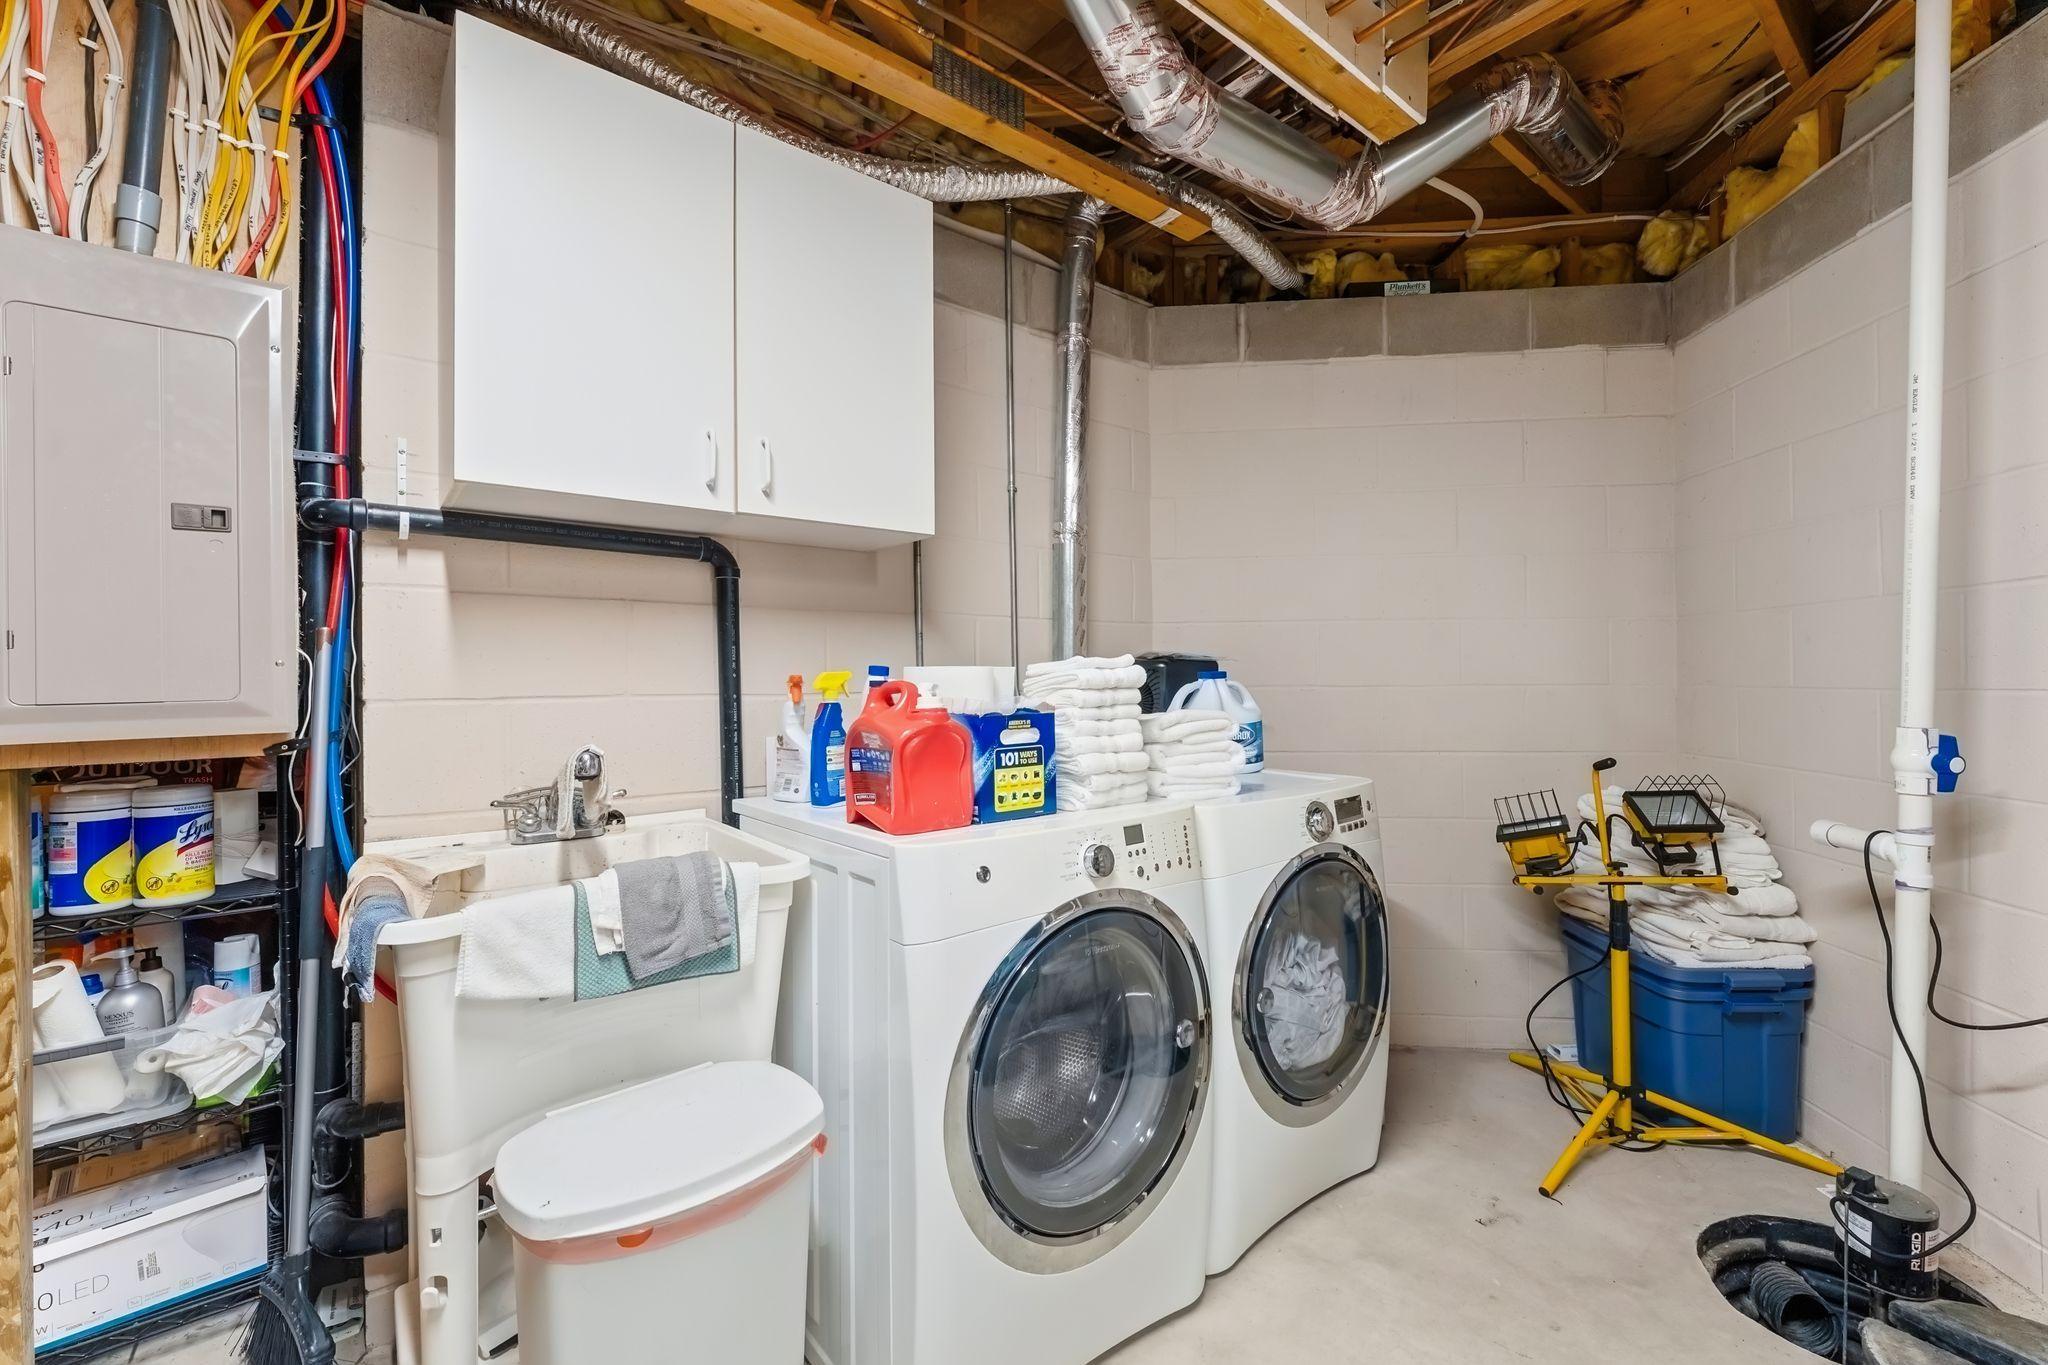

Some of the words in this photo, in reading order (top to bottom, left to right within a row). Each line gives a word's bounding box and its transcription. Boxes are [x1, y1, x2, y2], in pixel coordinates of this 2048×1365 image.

[1000, 751, 1019, 766] 101
[1019, 750, 1038, 758] WAYS
[183, 776, 213, 784] TRASH
[104, 1010, 135, 1020] NEXXUS
[1910, 1232, 1921, 1272] RIGID
